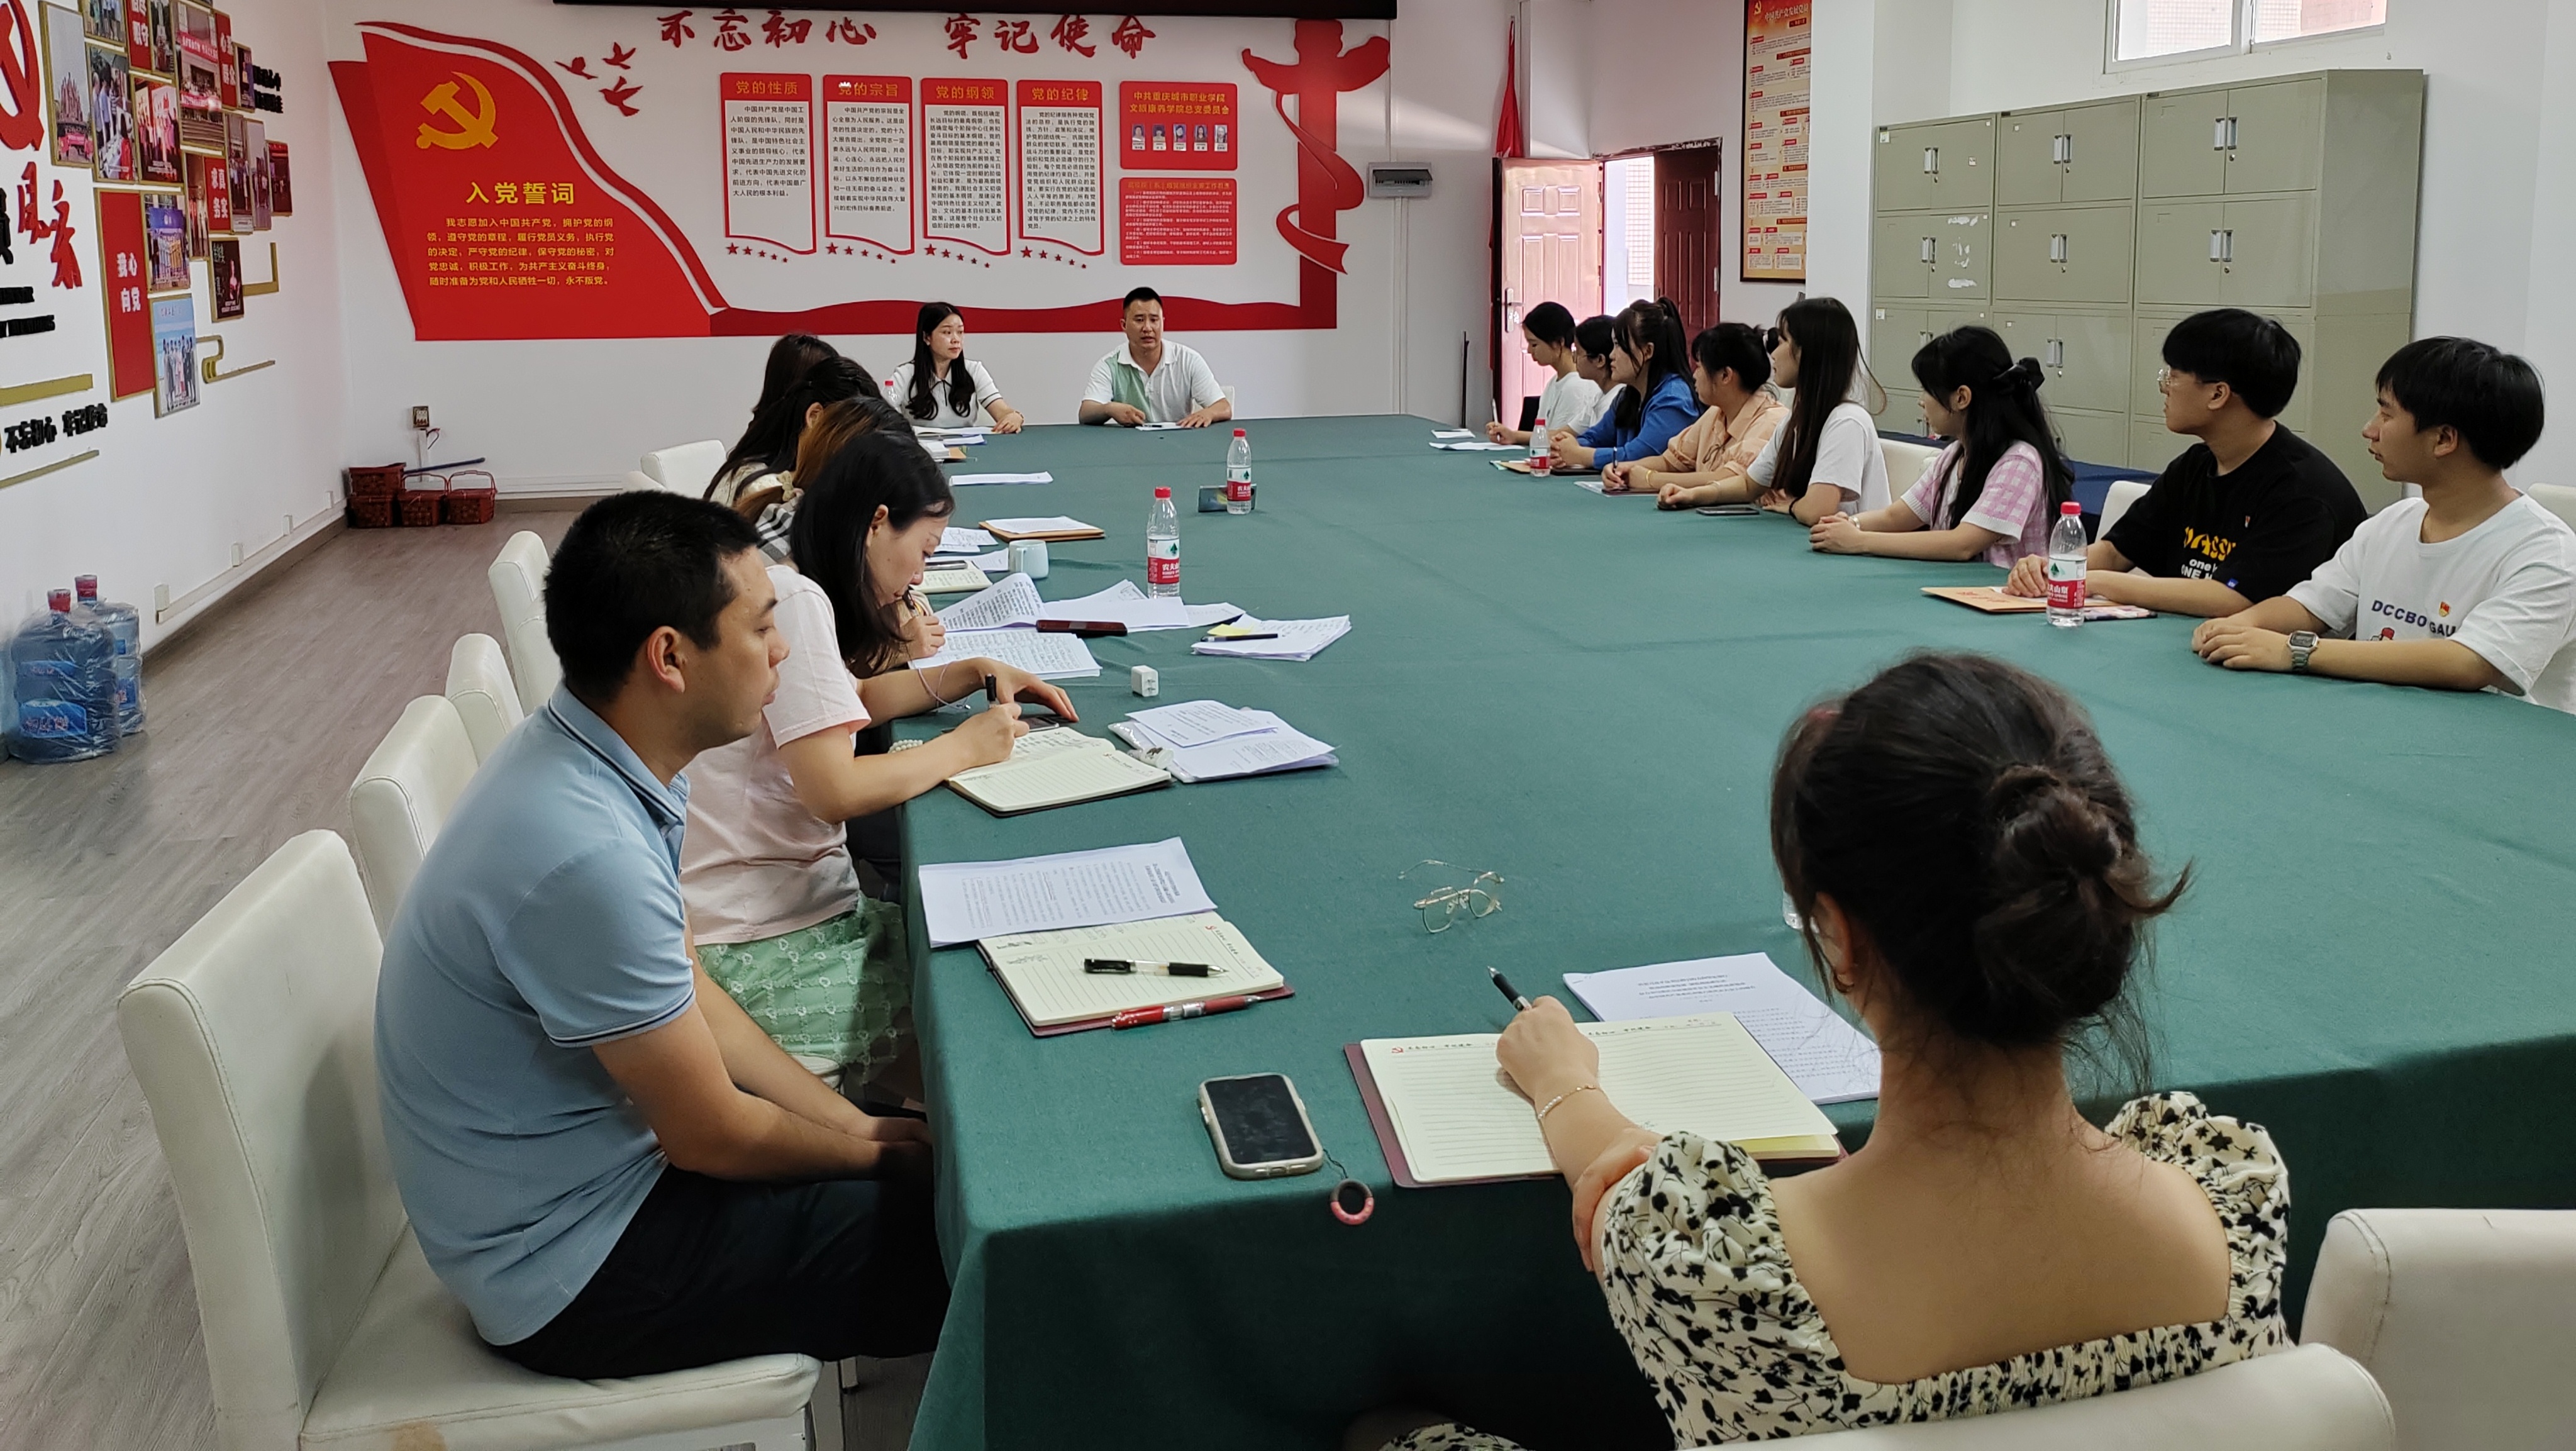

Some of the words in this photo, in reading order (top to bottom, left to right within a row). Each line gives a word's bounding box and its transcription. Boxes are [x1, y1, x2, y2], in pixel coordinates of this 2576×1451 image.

[657, 9, 877, 51] 不忘初心
[944, 13, 1156, 59] 牢记使命
[736, 81, 798, 95] 党的性质
[838, 81, 899, 97] 党的宗旨
[936, 86, 995, 99] 党的纲领
[1031, 87, 1089, 101] 党的纪律
[1134, 91, 1225, 103] 中共重庆城市职业学院
[730, 116, 804, 124] 人阶级的先锋队，同时是
[466, 182, 574, 204] 入党誓词
[446, 218, 613, 227] 我志愿加入中国共产党，拥护党的纲
[426, 233, 614, 242] 领，遵守党的章程，履行党员义务，执行党
[427, 248, 614, 256] 的决定，严守党的纪律，保守党的秘密，对
[428, 262, 609, 270] 党忠诚，积极工作，为共产主义奋斗终身，
[429, 277, 608, 286] 随时准备为党和人民牺牲一切，永不叛党。
[2189, 559, 2212, 572] one
[2048, 584, 2068, 594] 夫山泉
